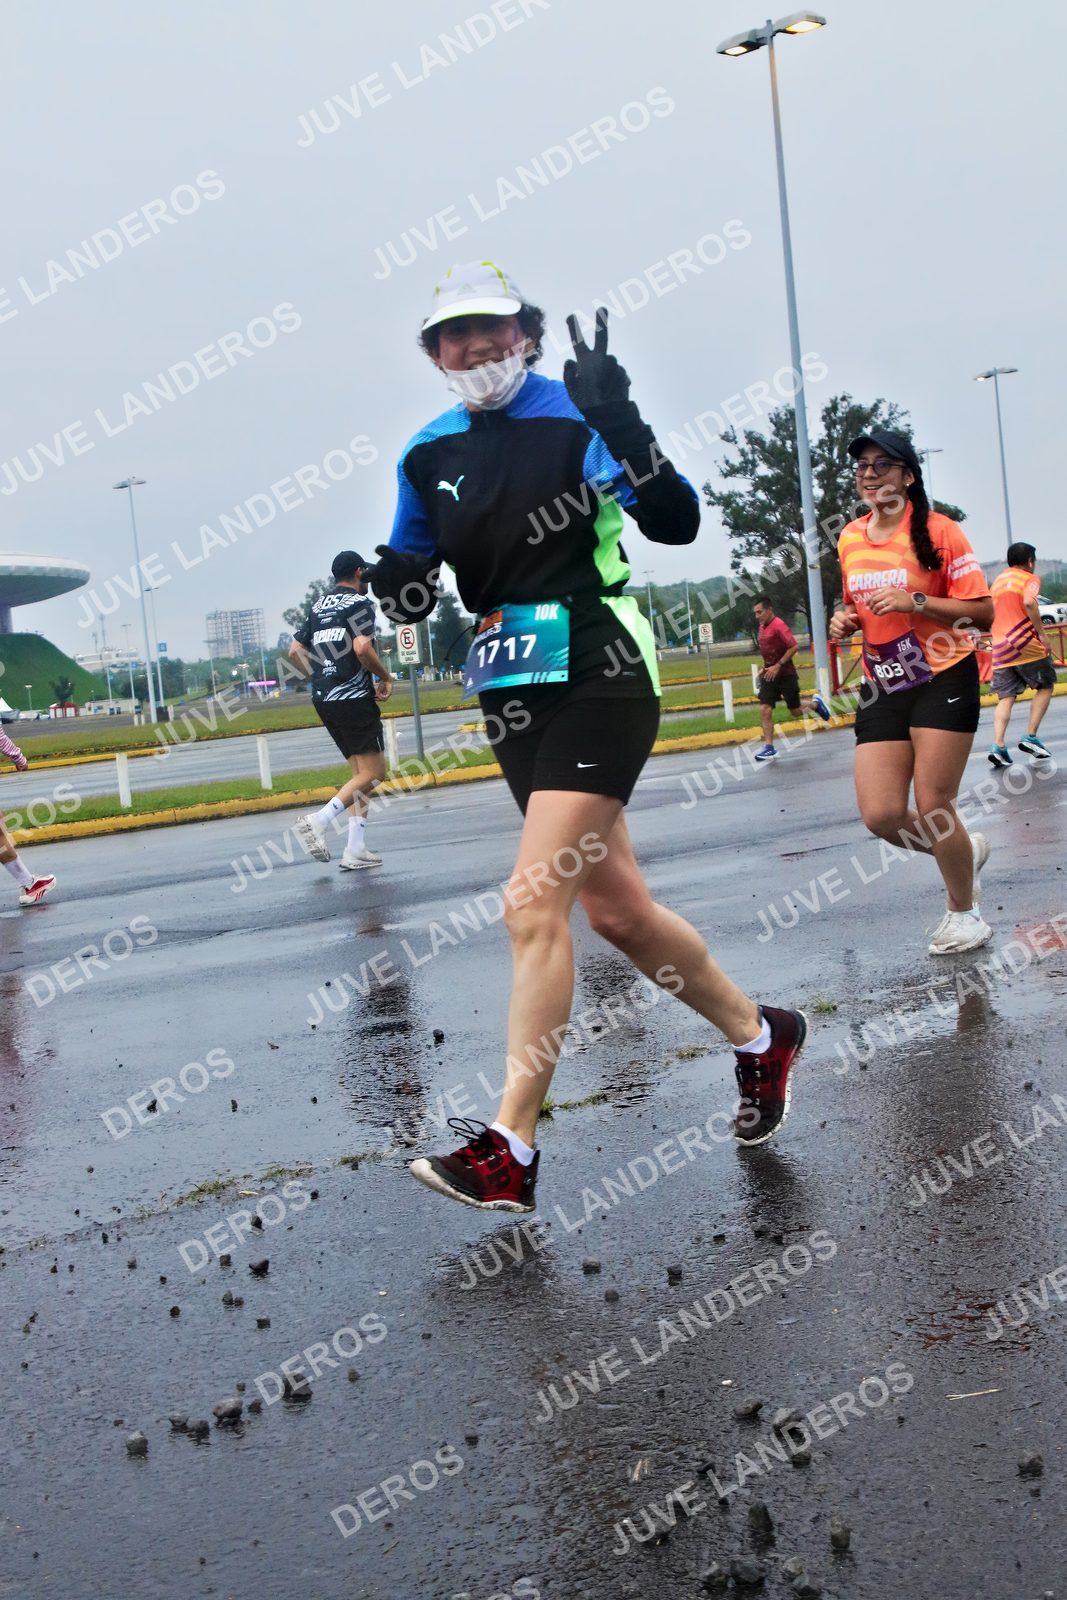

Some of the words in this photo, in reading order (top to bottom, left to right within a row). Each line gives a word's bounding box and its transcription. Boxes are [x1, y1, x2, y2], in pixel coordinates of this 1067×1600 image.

[849, 568, 908, 592] CARRERA
[535, 604, 560, 620] 10K
[477, 634, 537, 668] 1717
[897, 637, 912, 652] 15K
[874, 662, 904, 678] 803
